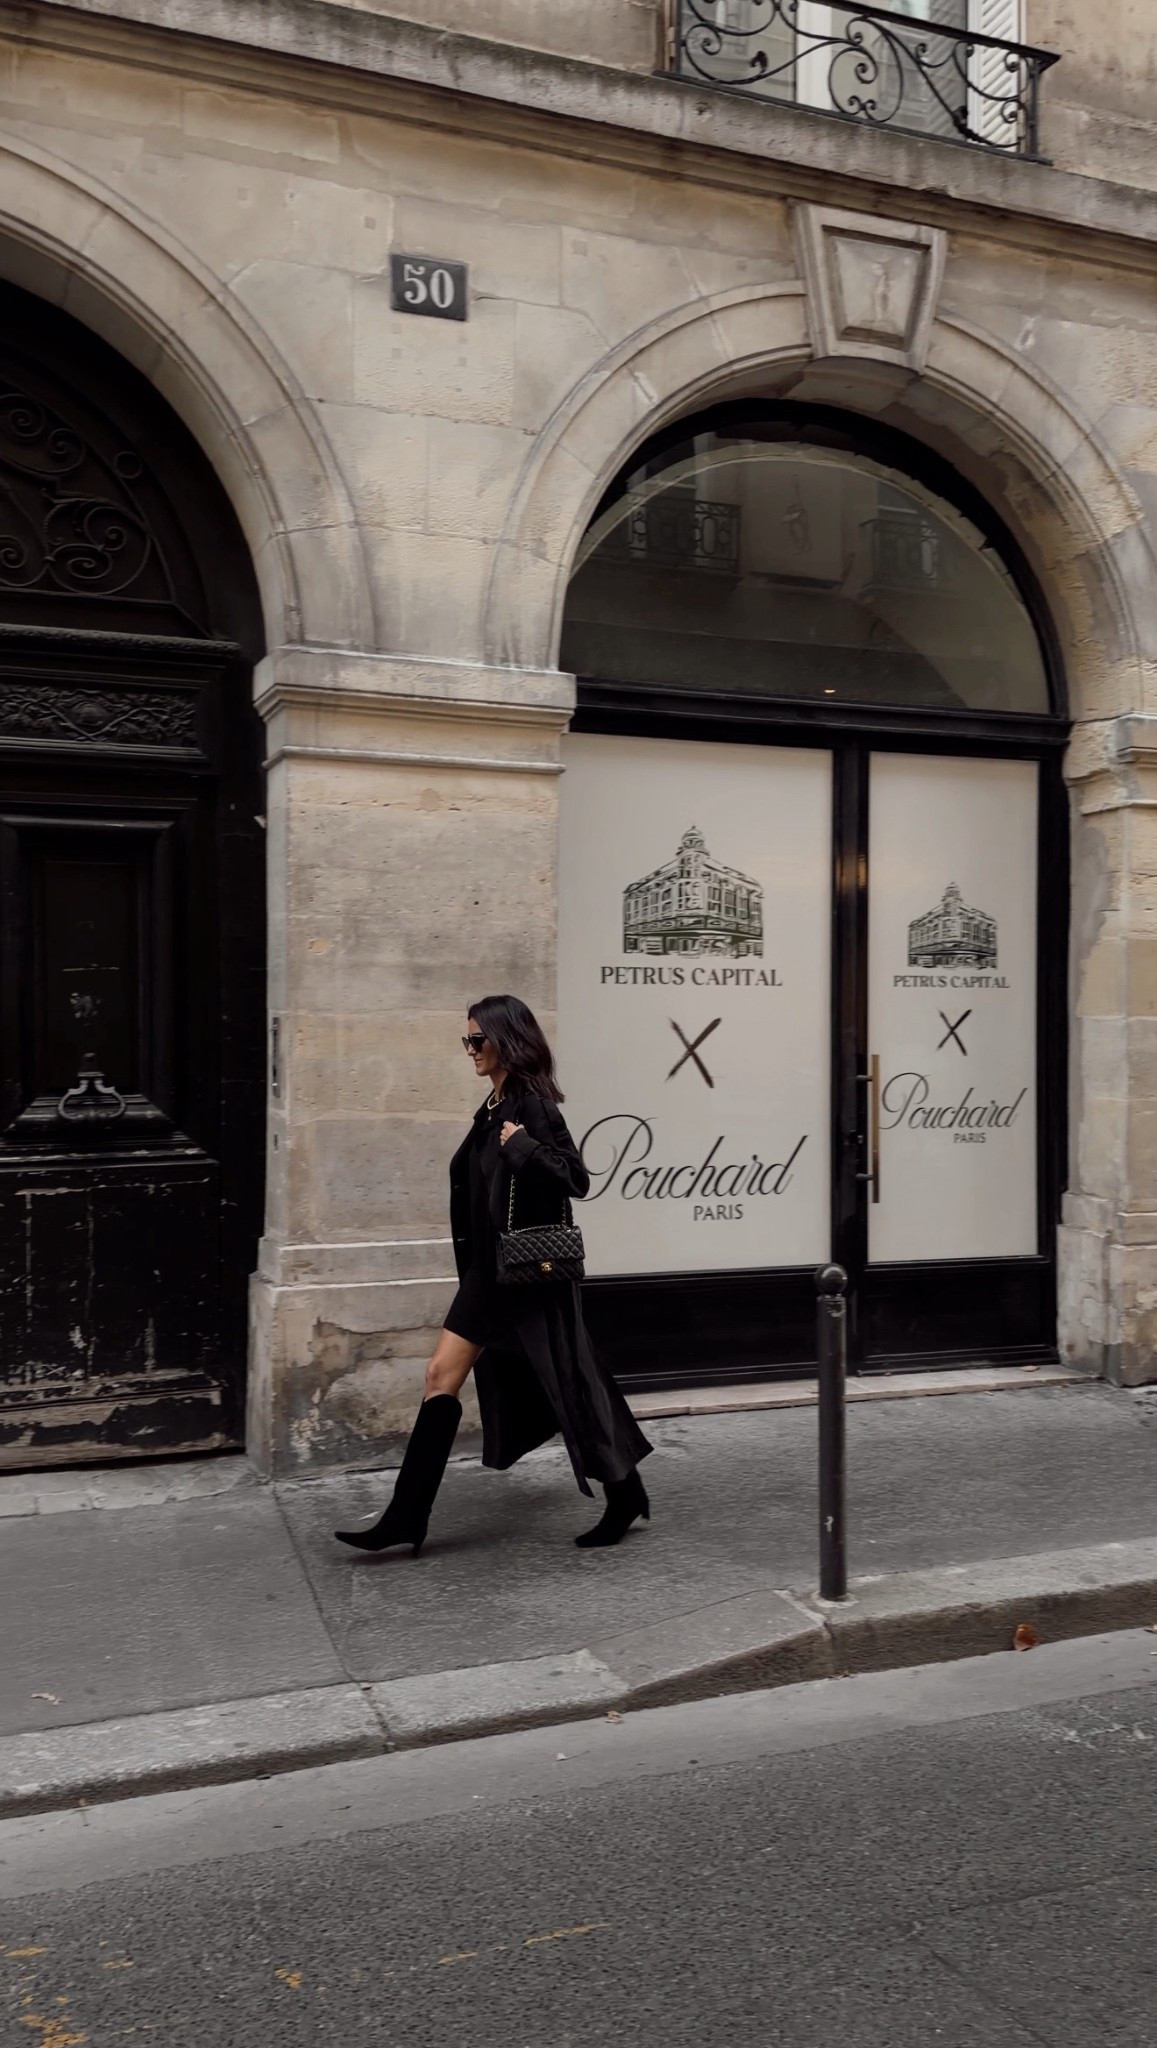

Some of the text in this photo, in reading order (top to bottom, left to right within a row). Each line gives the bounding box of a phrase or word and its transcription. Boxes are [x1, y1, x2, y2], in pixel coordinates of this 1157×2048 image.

[403, 263, 455, 309] 50
[600, 966, 783, 987] PETRUS CAPITAL
[893, 974, 1011, 989] PETRUS CAPITAL
[879, 1072, 1028, 1130] Pouchard
[953, 1132, 987, 1144] PARIS
[577, 1113, 808, 1202] Pouchard
[693, 1203, 744, 1222] PARIS
